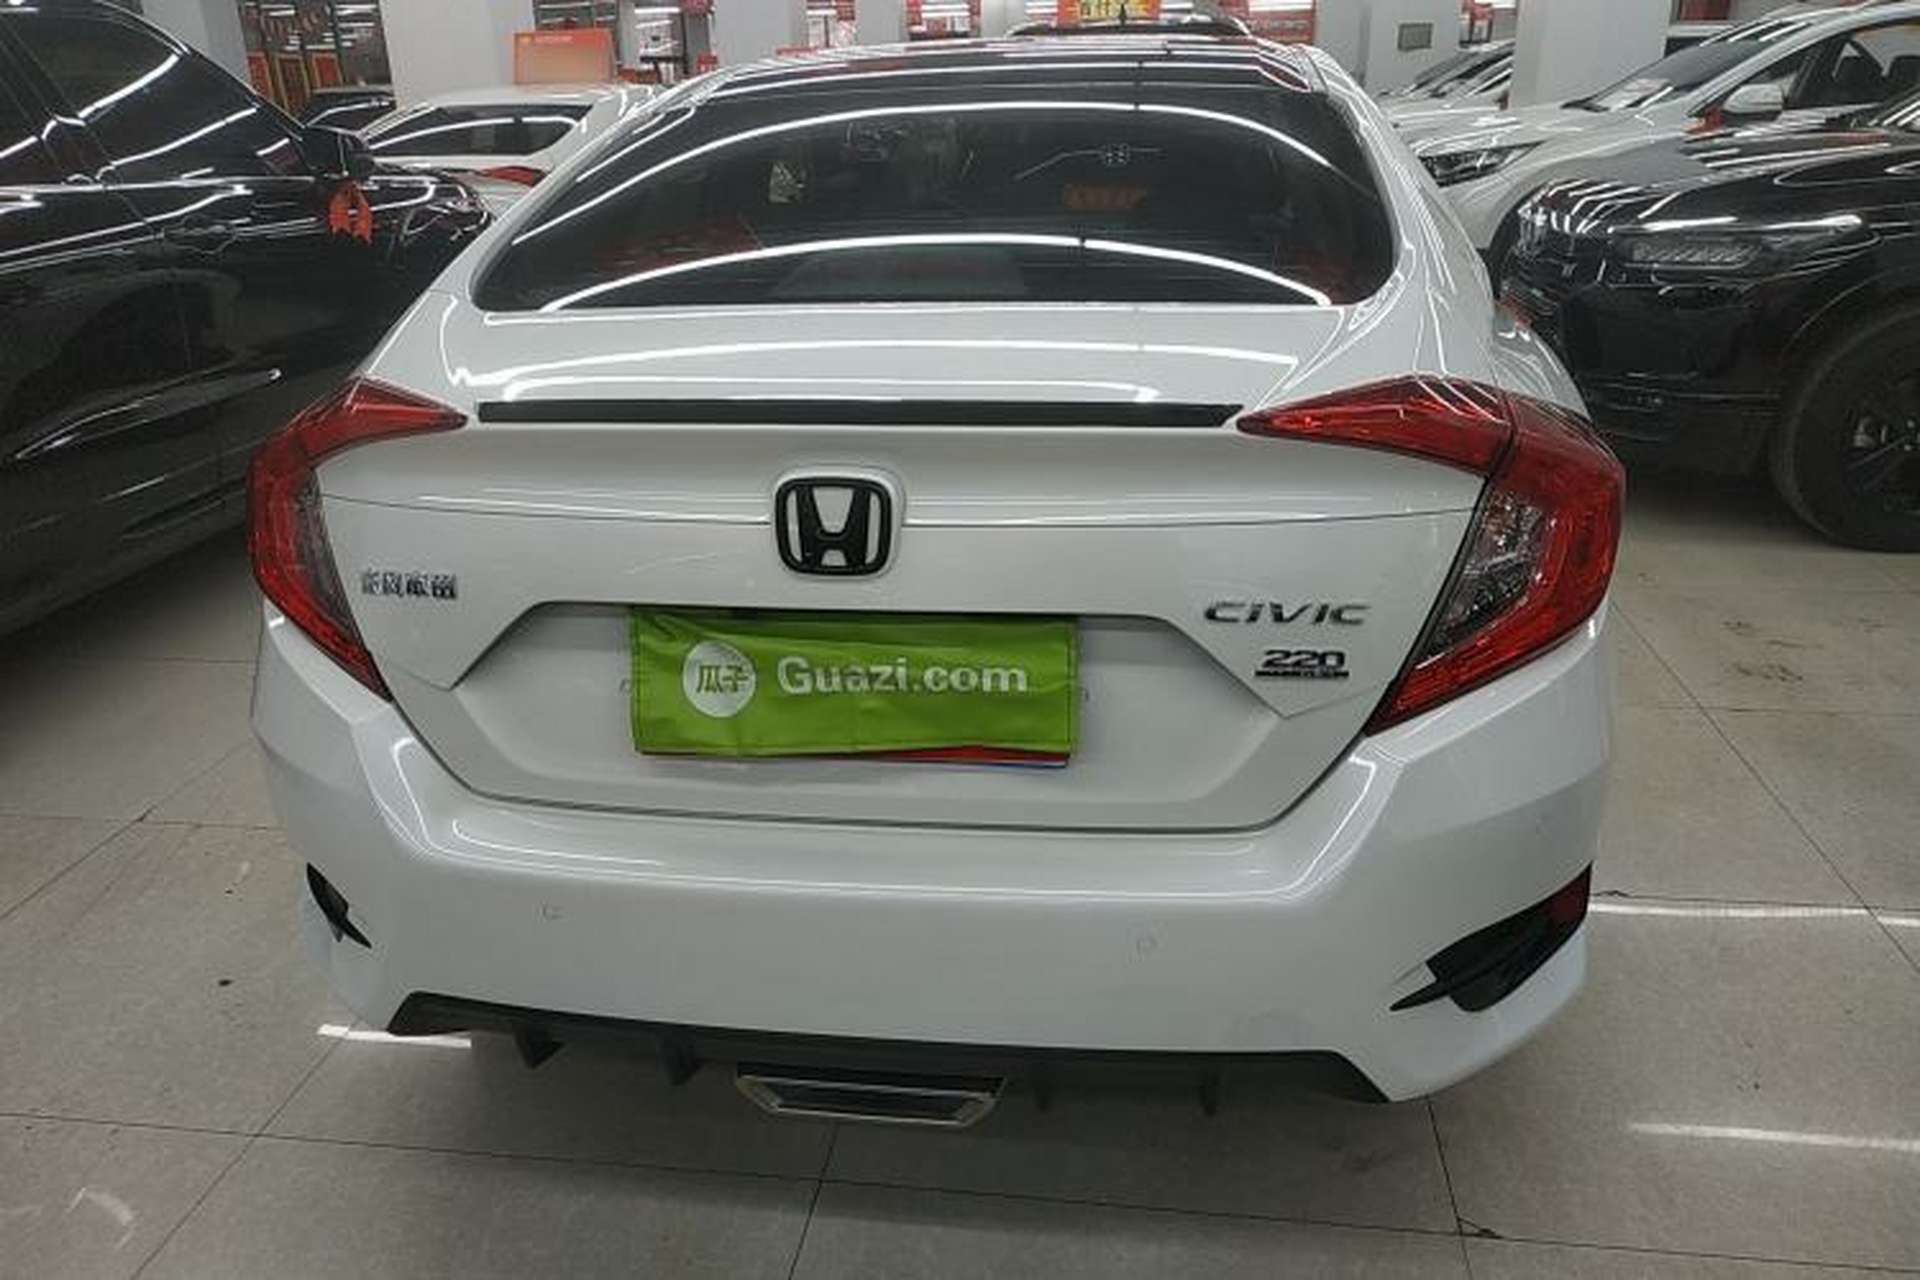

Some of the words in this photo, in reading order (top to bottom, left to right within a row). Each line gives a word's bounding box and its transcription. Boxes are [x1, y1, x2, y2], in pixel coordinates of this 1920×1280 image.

[1204, 601, 1371, 626] CIVIC
[1262, 649, 1347, 669] 220
[697, 664, 749, 694] 瓜子
[777, 655, 1027, 694] Guazi.com
